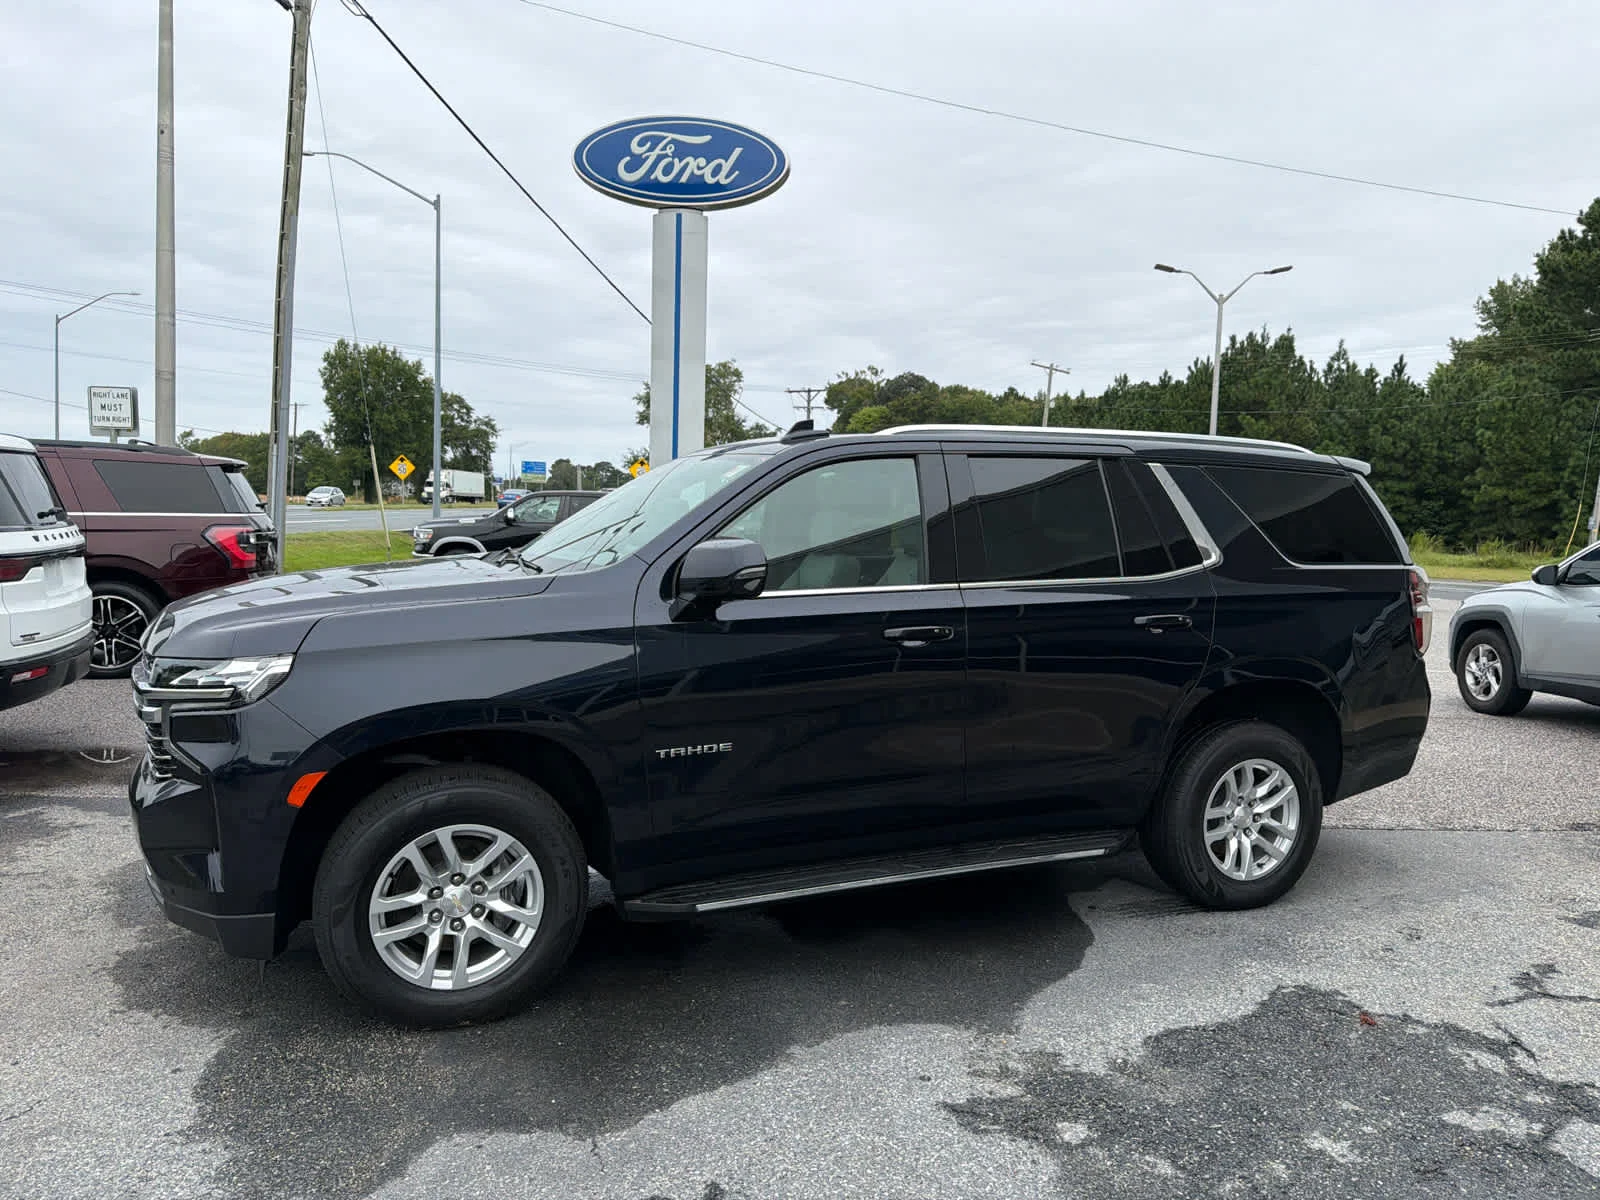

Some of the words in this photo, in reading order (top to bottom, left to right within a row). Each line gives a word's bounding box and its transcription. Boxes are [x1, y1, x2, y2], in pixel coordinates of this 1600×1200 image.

[617, 131, 744, 184] Ford
[92, 391, 111, 399] RIGHT
[112, 392, 129, 400] LANE
[100, 403, 123, 412] MUST
[93, 415, 111, 423] TURN
[112, 416, 130, 424] RIGHT
[655, 742, 734, 759] TAHOE
